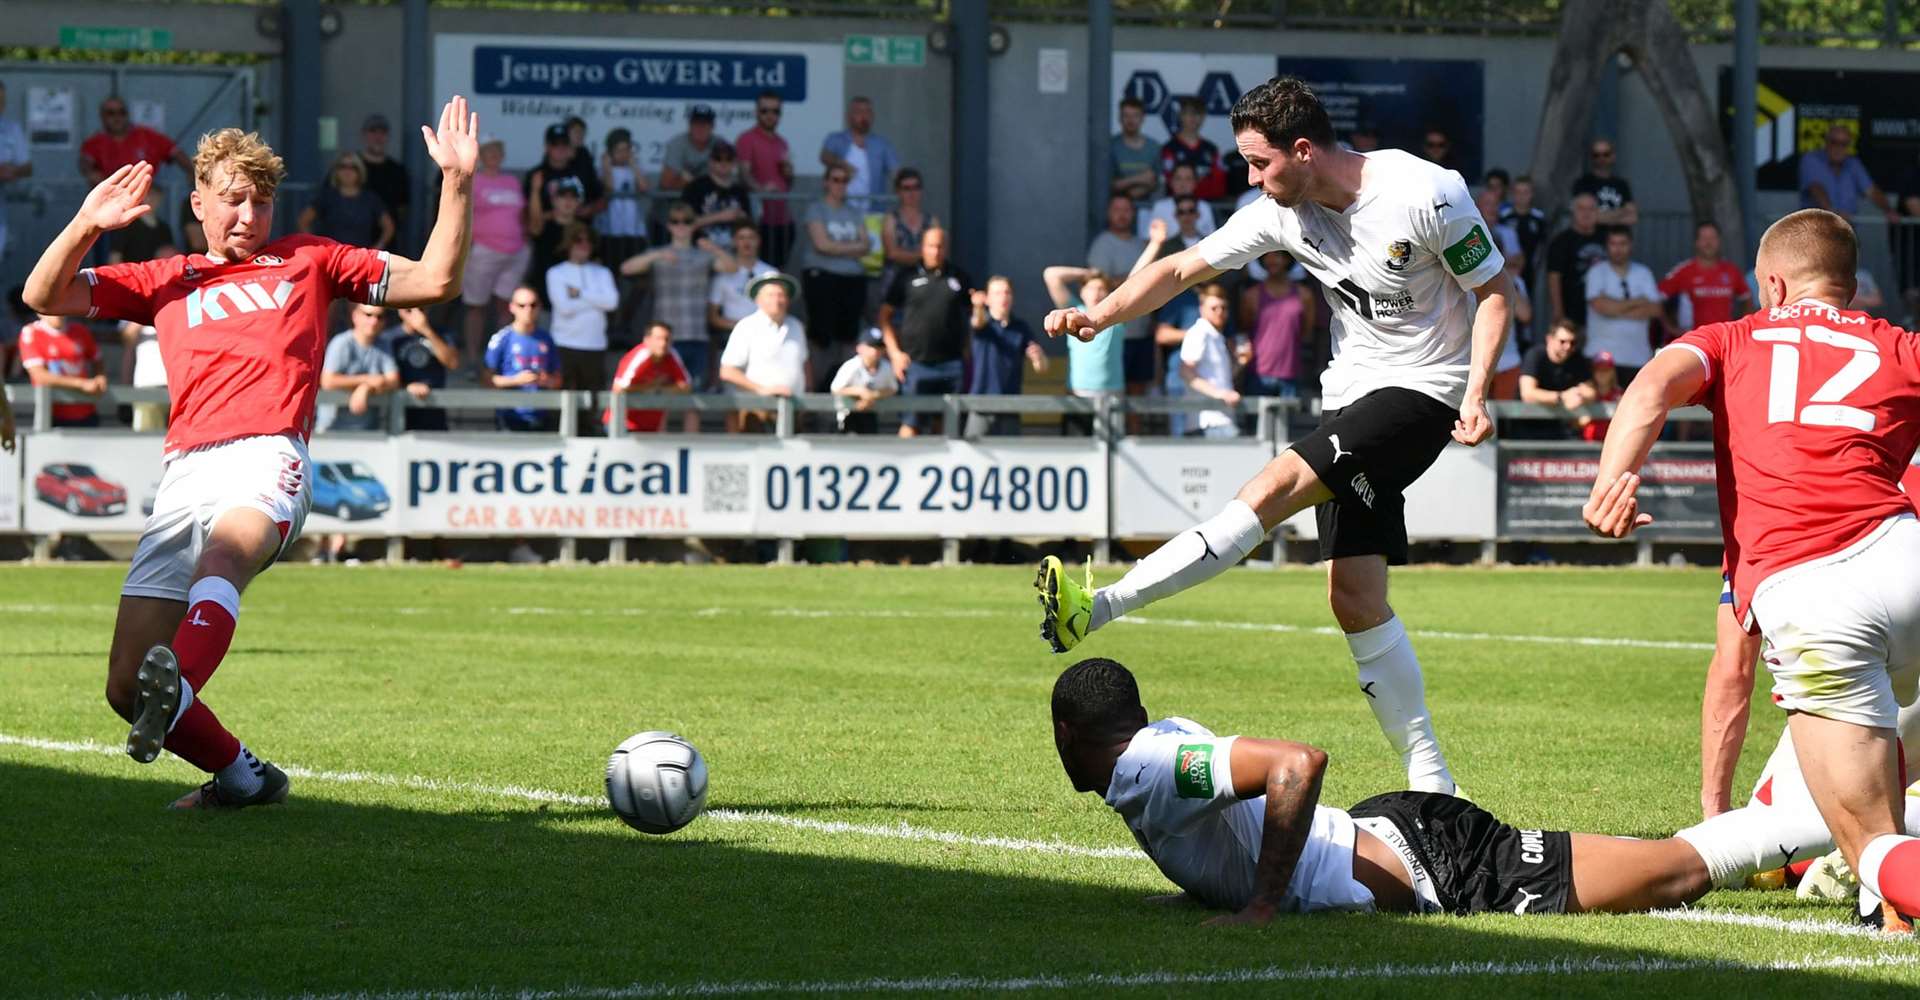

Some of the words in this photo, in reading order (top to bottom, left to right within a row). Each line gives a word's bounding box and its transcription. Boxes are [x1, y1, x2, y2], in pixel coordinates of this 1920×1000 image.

[497, 55, 605, 89] Jenpro
[613, 57, 723, 86] GWER
[732, 62, 787, 88] Ltd
[604, 101, 675, 124] Cutting
[1460, 245, 1482, 263] FOX
[1375, 295, 1414, 310] POWER
[1375, 303, 1416, 318] HOUSE
[1751, 324, 1881, 432] 12
[408, 448, 690, 507] practical
[766, 465, 902, 512] 01322
[919, 465, 1089, 512] 294800
[447, 506, 497, 529] CAR
[506, 507, 522, 529] &
[528, 507, 586, 529] VAN
[596, 507, 690, 529] RENTAL
[1190, 757, 1201, 785] FOX
[1385, 830, 1427, 883] LONSDALE
